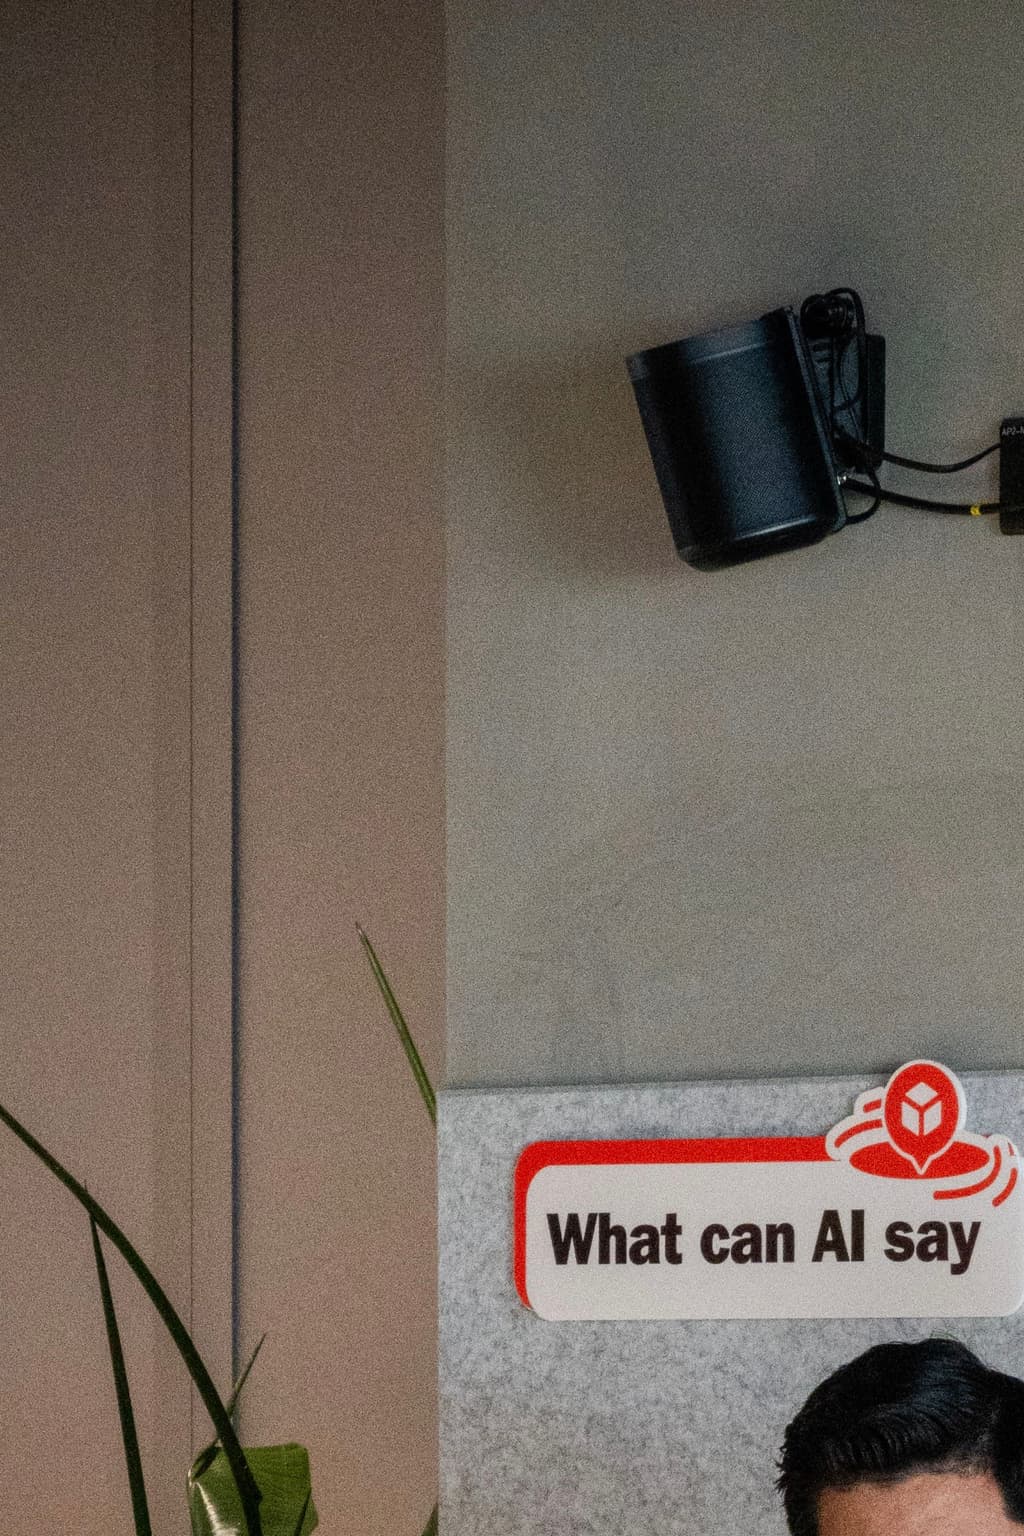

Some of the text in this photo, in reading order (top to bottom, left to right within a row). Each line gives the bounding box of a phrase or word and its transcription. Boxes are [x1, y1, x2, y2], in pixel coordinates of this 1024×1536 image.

[546, 1209, 982, 1275] What can AI say
